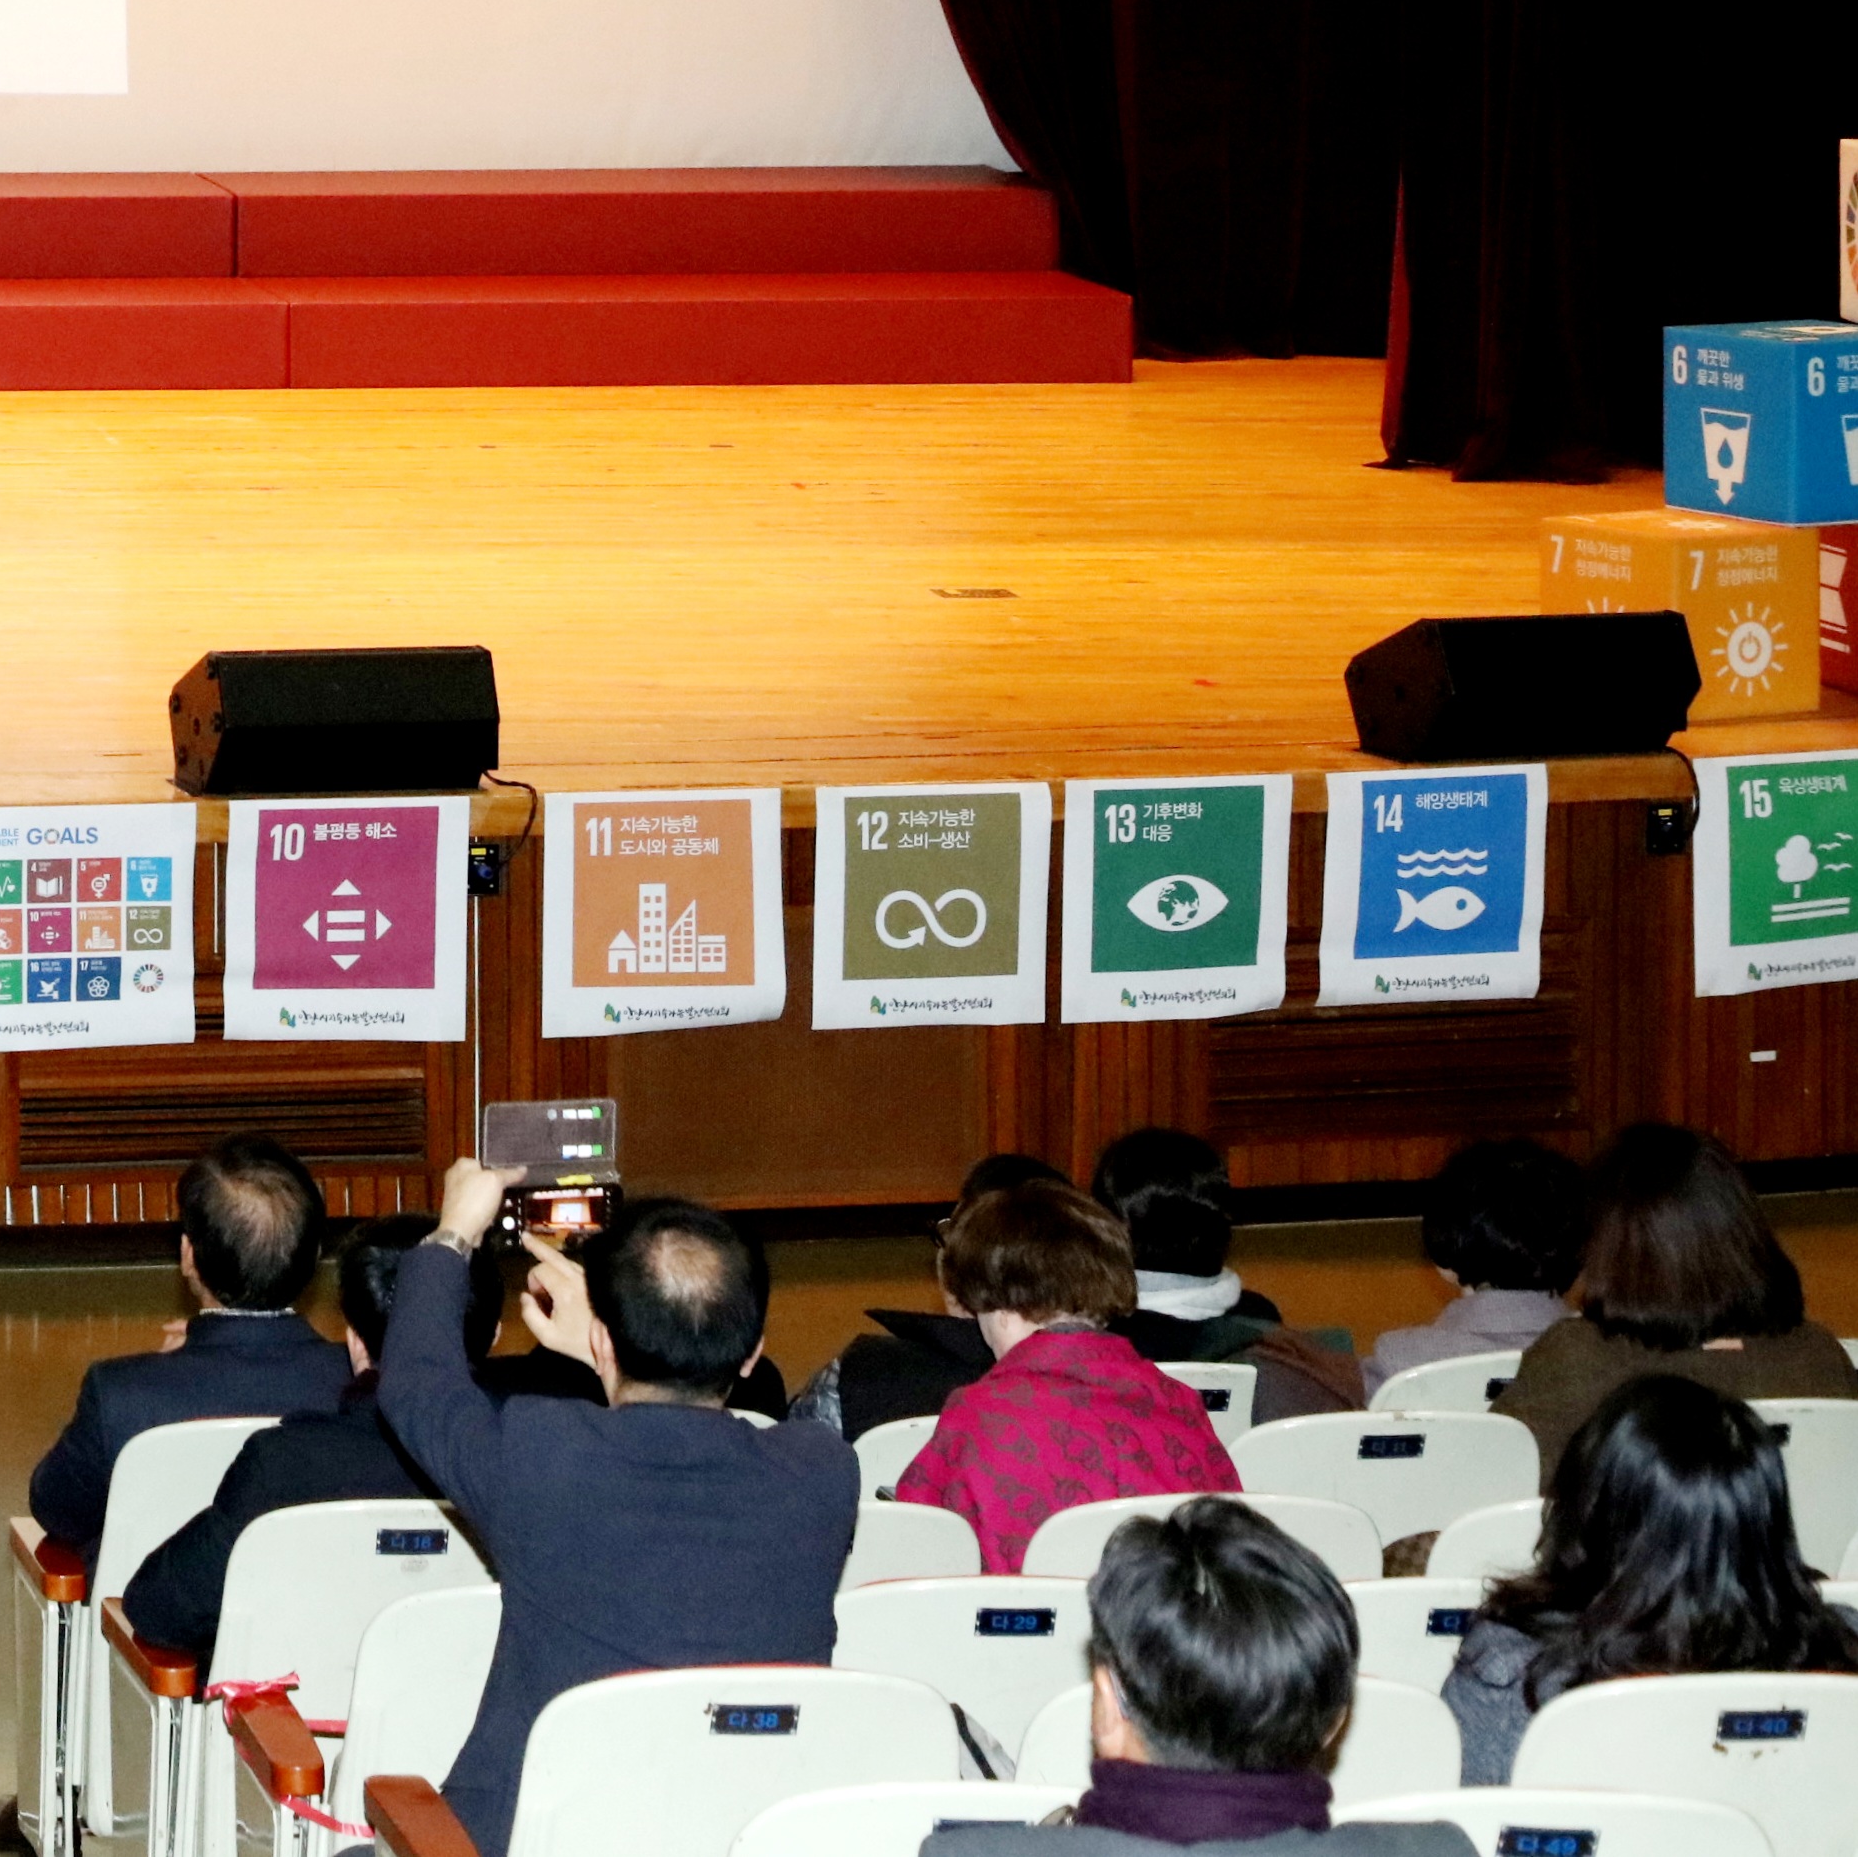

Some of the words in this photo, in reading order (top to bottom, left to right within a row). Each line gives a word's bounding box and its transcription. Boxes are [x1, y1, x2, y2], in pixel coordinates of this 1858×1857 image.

[1672, 345, 1687, 385] 6
[1697, 347, 1731, 368] 깨끗한
[1697, 368, 1719, 388] 물과
[1722, 370, 1745, 391] 위생
[1807, 357, 1825, 397] 6
[1550, 535, 1565, 574] 7
[1690, 551, 1705, 591] 7
[1779, 774, 1848, 795] 육상생태계
[1415, 790, 1488, 810] 해양생태계
[1739, 779, 1772, 819] 15
[897, 807, 976, 828] 지속가능한
[1143, 802, 1203, 821] 기후변화
[1373, 793, 1404, 834] 14
[313, 821, 361, 842] 불평등
[365, 820, 397, 840] 해소
[620, 815, 698, 834] 지속가능한
[856, 810, 889, 851] 12
[1103, 804, 1137, 844] 13
[1143, 824, 1173, 842] 대응
[27, 827, 98, 845] GOALS
[270, 823, 307, 862] 10
[585, 816, 613, 857] 11
[619, 837, 667, 857] 도시와
[670, 836, 720, 856] 공동체
[30, 912, 38, 921] 10
[129, 910, 137, 920] 12
[80, 961, 88, 971] 17
[991, 1615, 1009, 1631] 다
[1014, 1615, 1038, 1630] 29
[728, 1712, 747, 1728] 다
[753, 1713, 780, 1728] 38
[1734, 1720, 1754, 1736] 다
[1760, 1718, 1788, 1735] 40
[1517, 1834, 1538, 1855] 다
